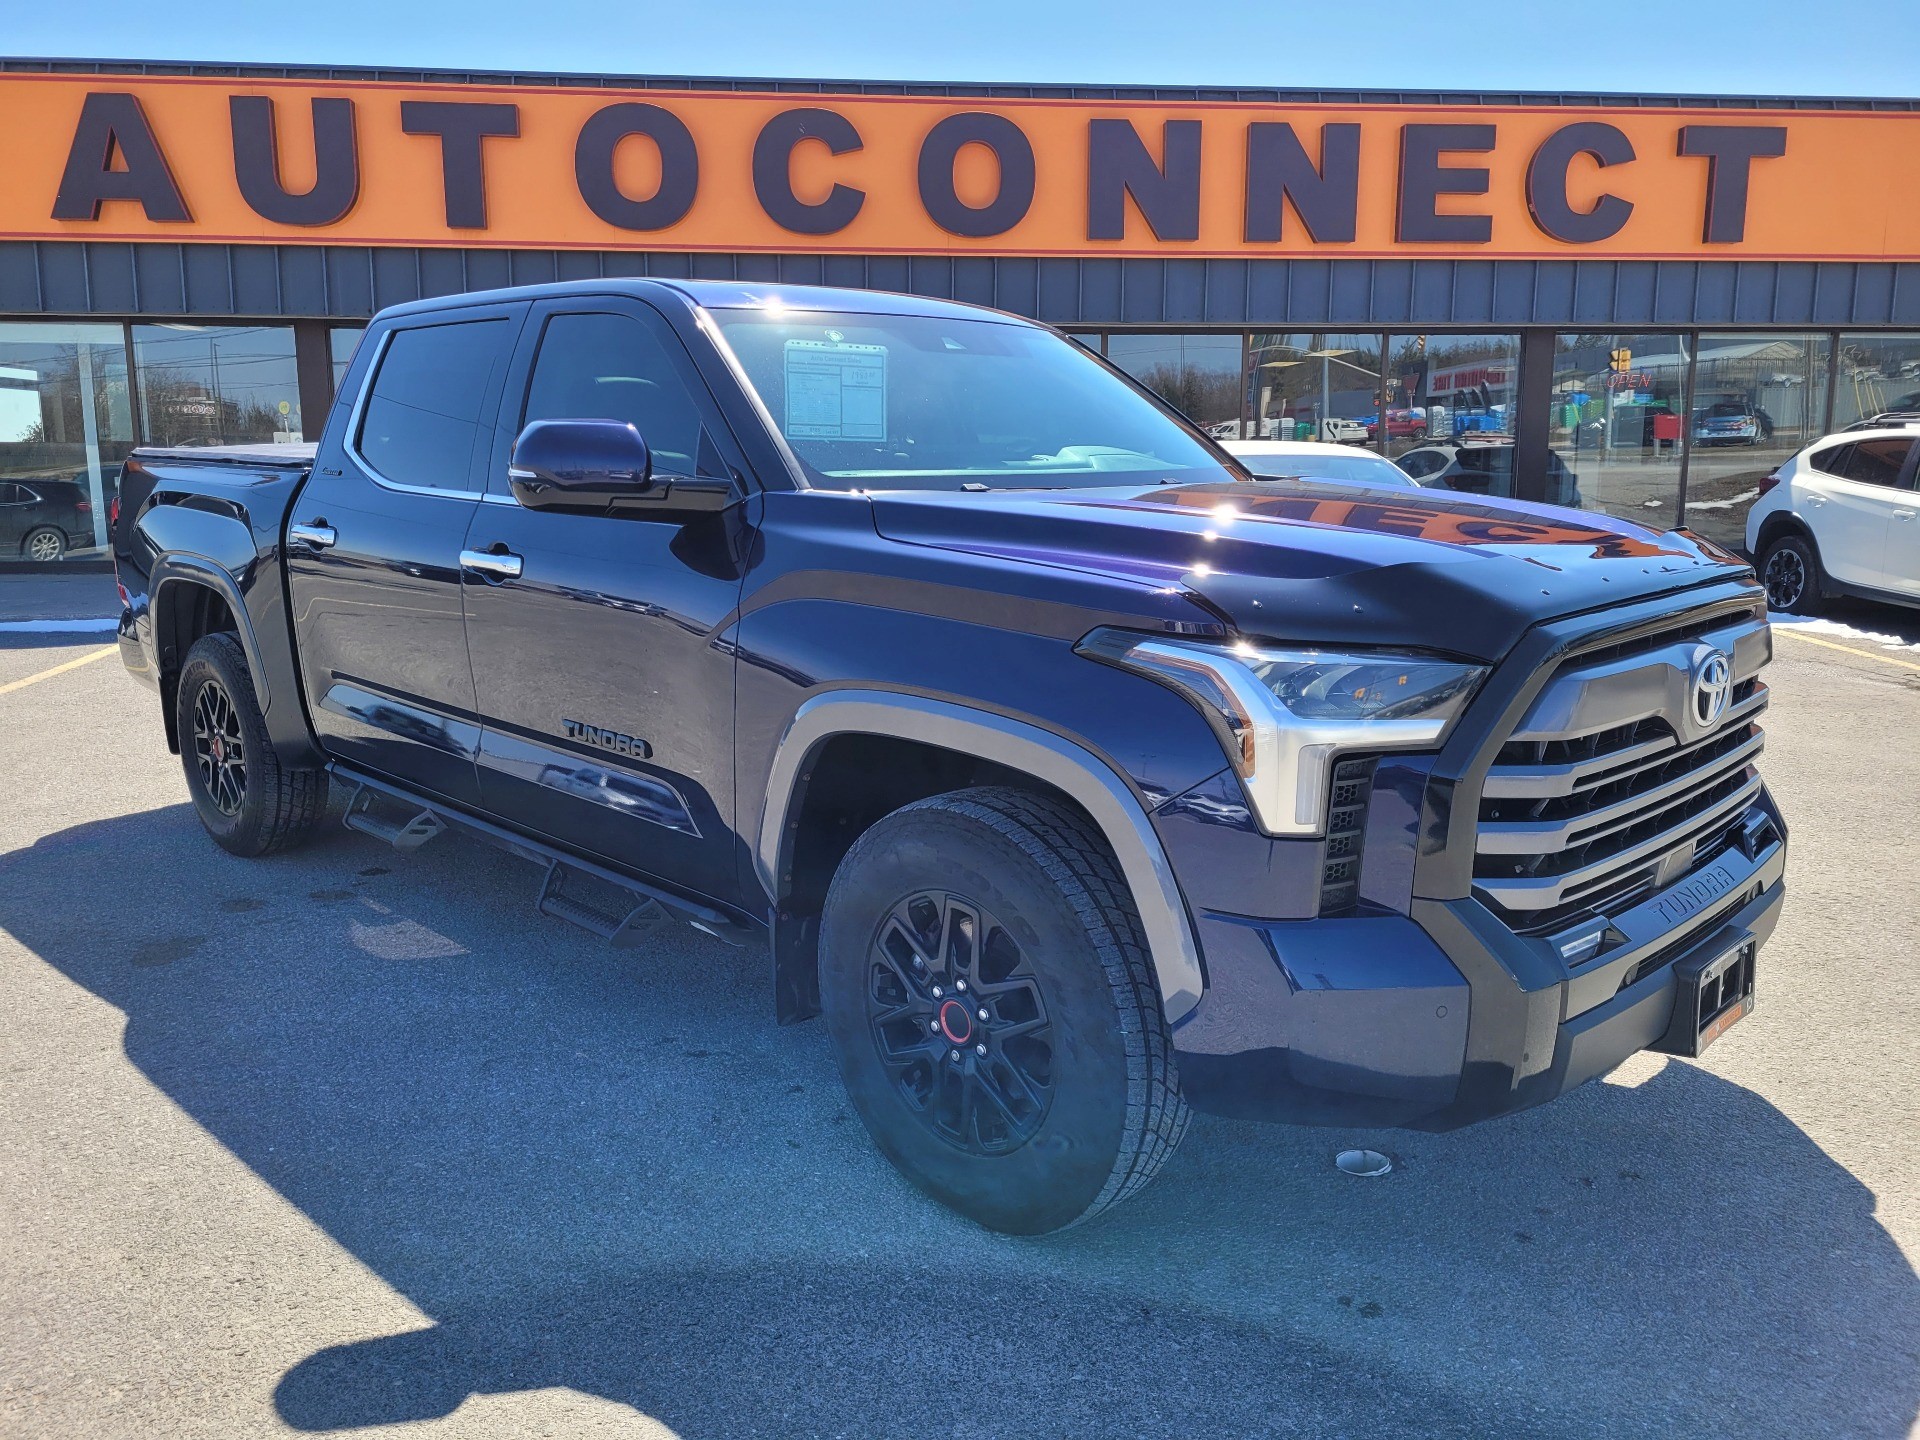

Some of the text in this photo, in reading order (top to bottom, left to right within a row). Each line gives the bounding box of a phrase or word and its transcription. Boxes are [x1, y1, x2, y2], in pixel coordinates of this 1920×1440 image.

[50, 90, 1788, 245] AUTOCONNECT
[1607, 374, 1651, 388] OPEN
[562, 718, 651, 759] TUNDRA
[1648, 865, 1736, 925] TUNDRA
